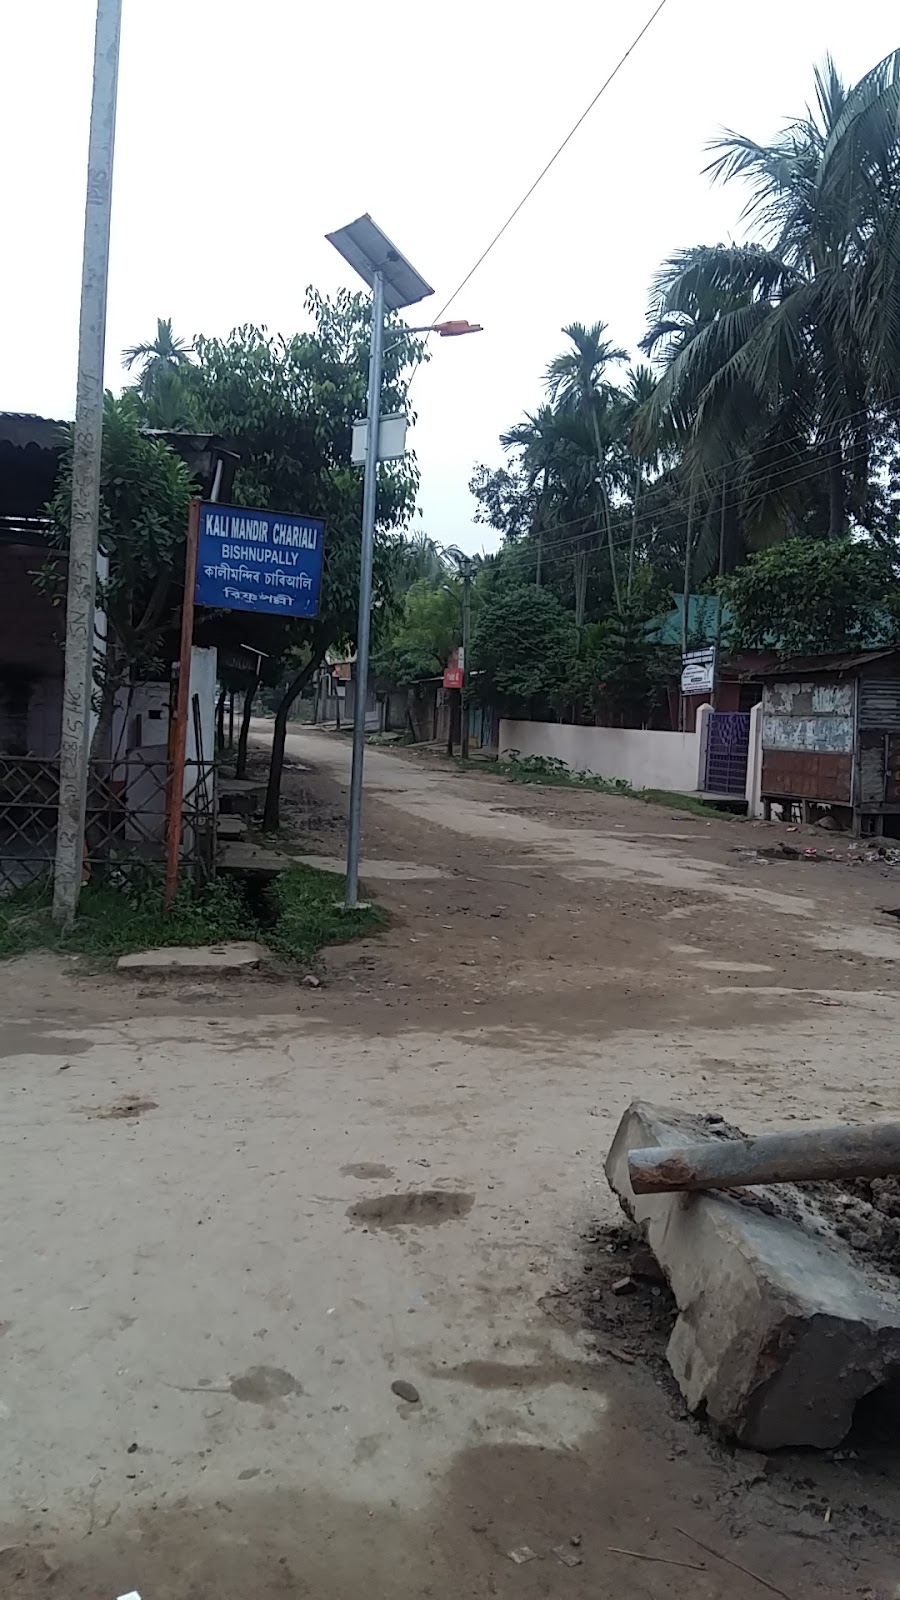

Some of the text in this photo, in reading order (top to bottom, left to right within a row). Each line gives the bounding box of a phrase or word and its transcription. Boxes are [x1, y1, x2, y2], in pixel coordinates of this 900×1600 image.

[206, 514, 318, 550] KALI MANDIR CHARIALI
[221, 544, 299, 566] BISHNUPALLY
